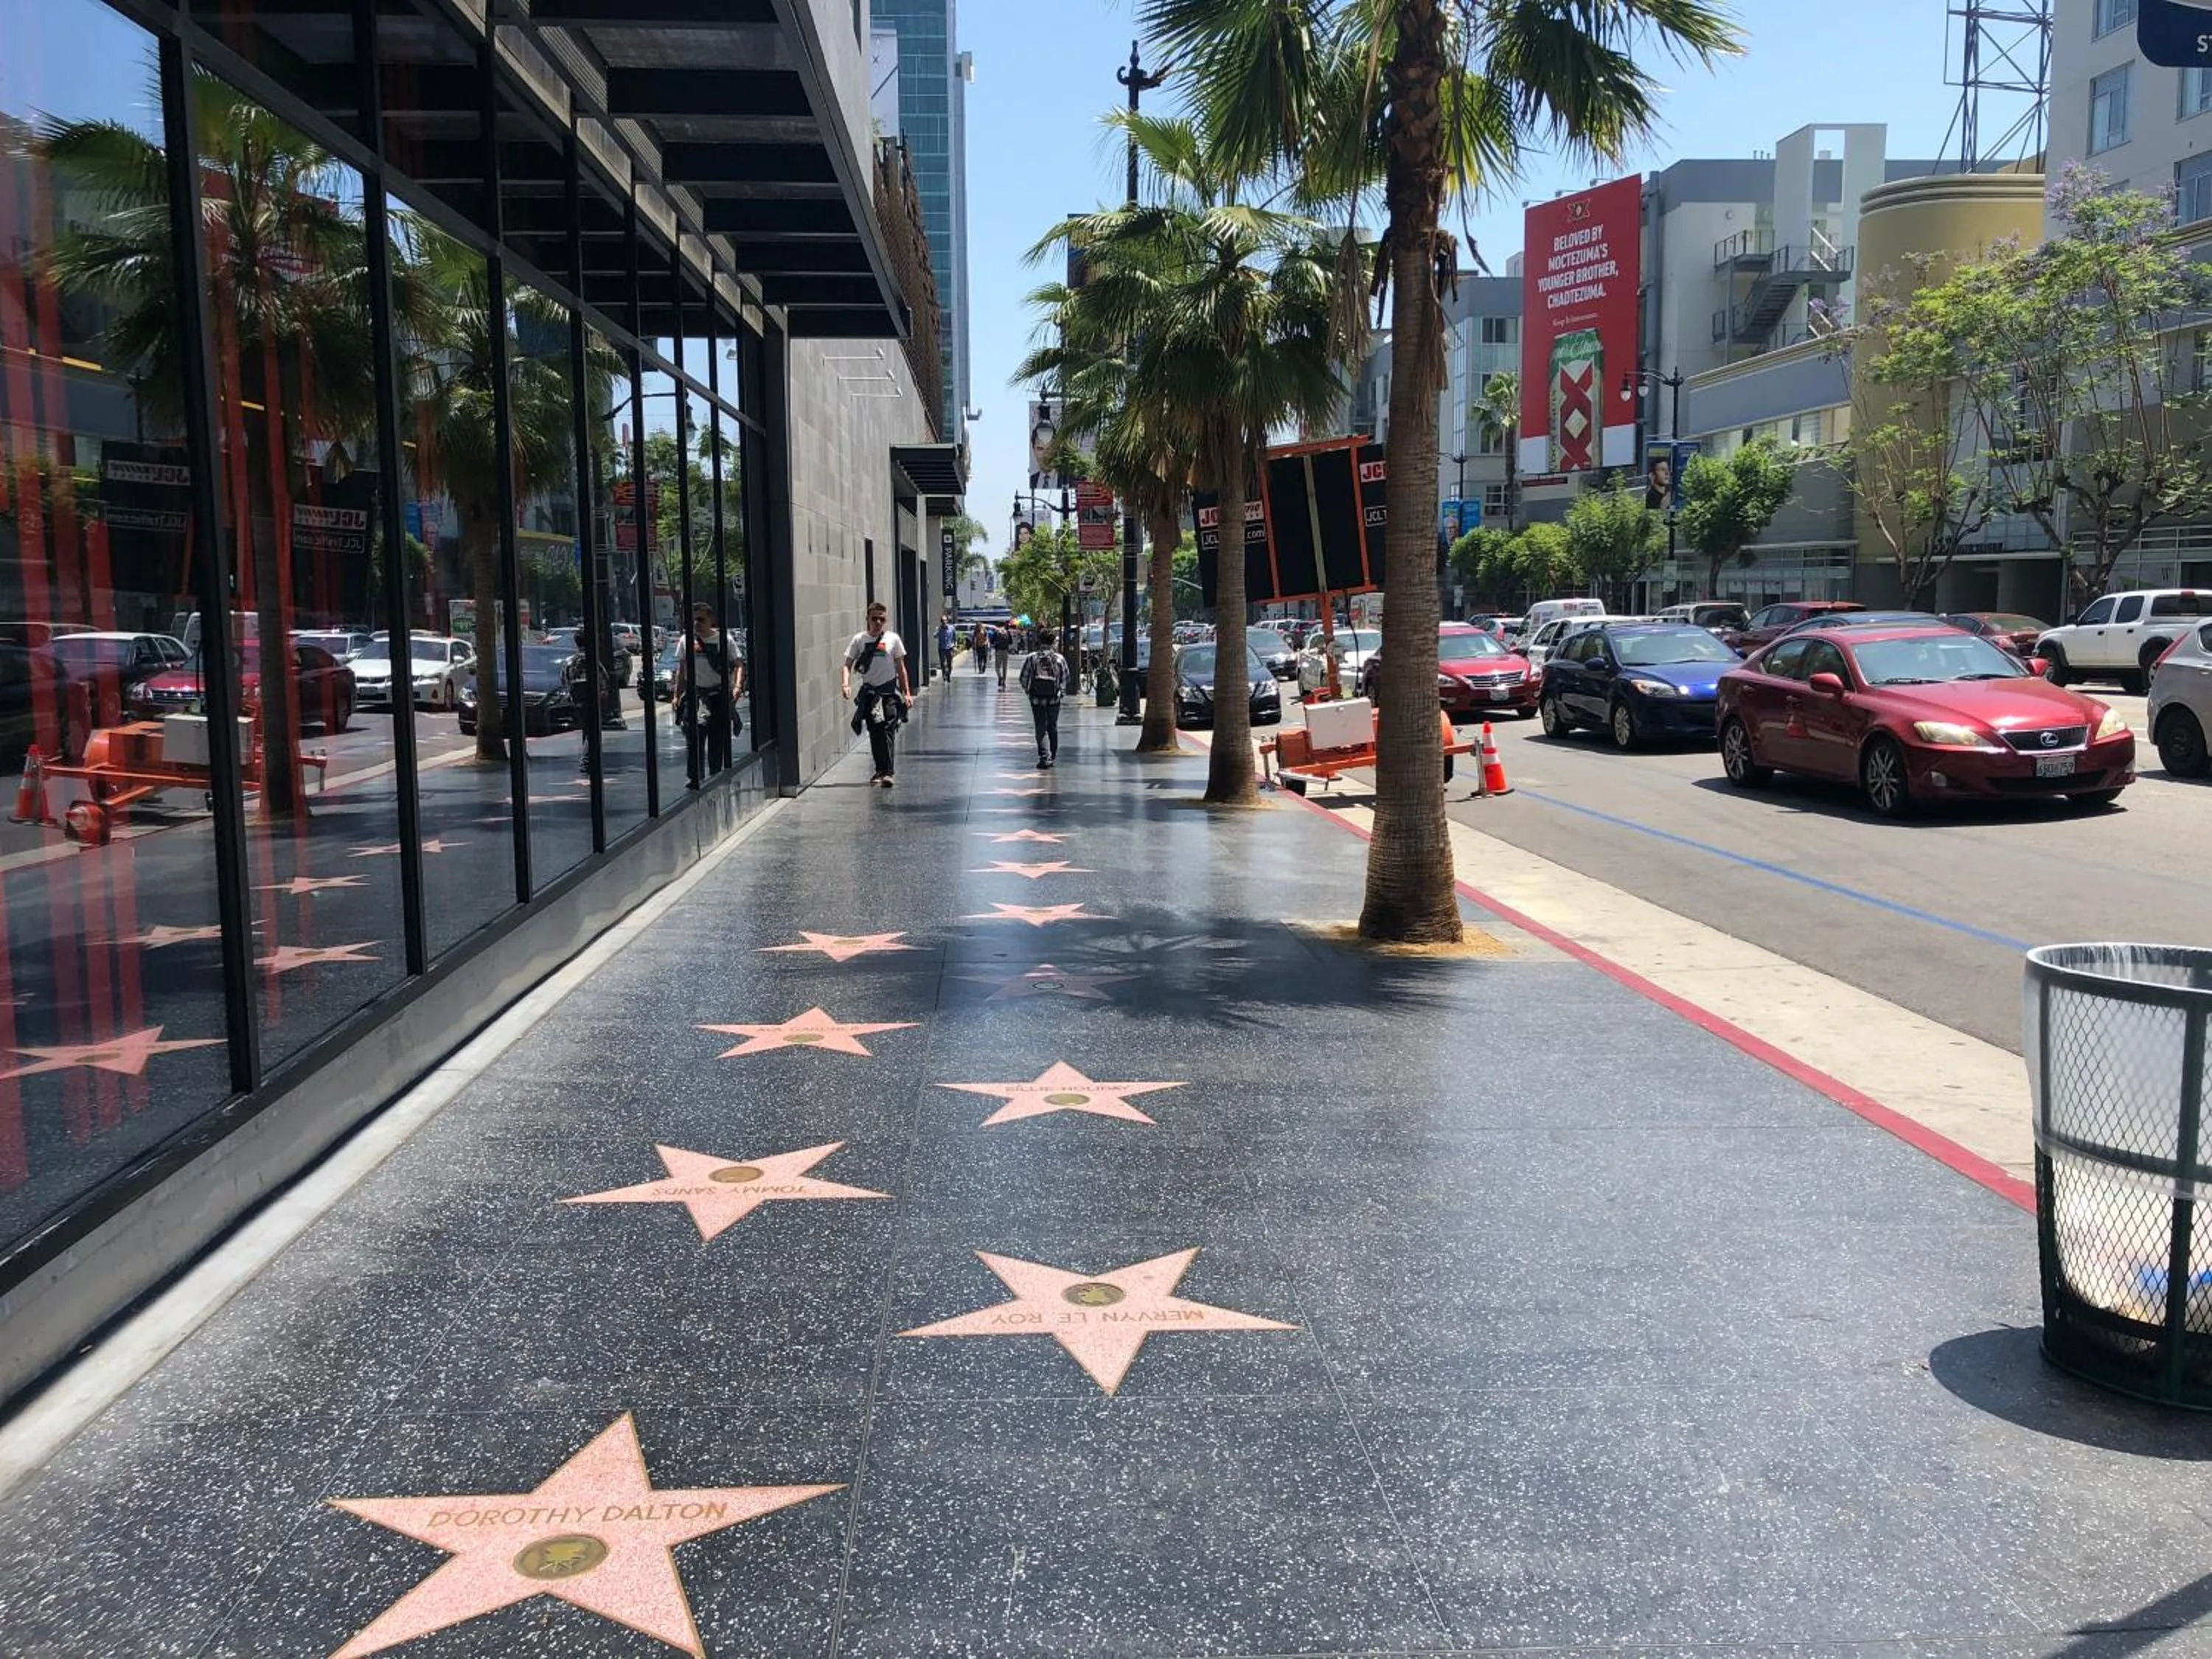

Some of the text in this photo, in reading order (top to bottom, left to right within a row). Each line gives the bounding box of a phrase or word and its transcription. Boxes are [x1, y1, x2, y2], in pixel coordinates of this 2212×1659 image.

[1554, 223, 1604, 252] BELOVED BY
[1548, 243, 1609, 272] MOCTEZUMA'S
[1537, 260, 1619, 294] YOUNGER BROTHER,
[1547, 282, 1607, 310] CHADTEZUMA.
[944, 547, 954, 589] PARKING
[651, 1185, 805, 1197] TOMMY SANDS
[991, 1308, 1204, 1325] MERVYN LE ROY
[426, 1501, 728, 1530] DOROTHY DALTON
